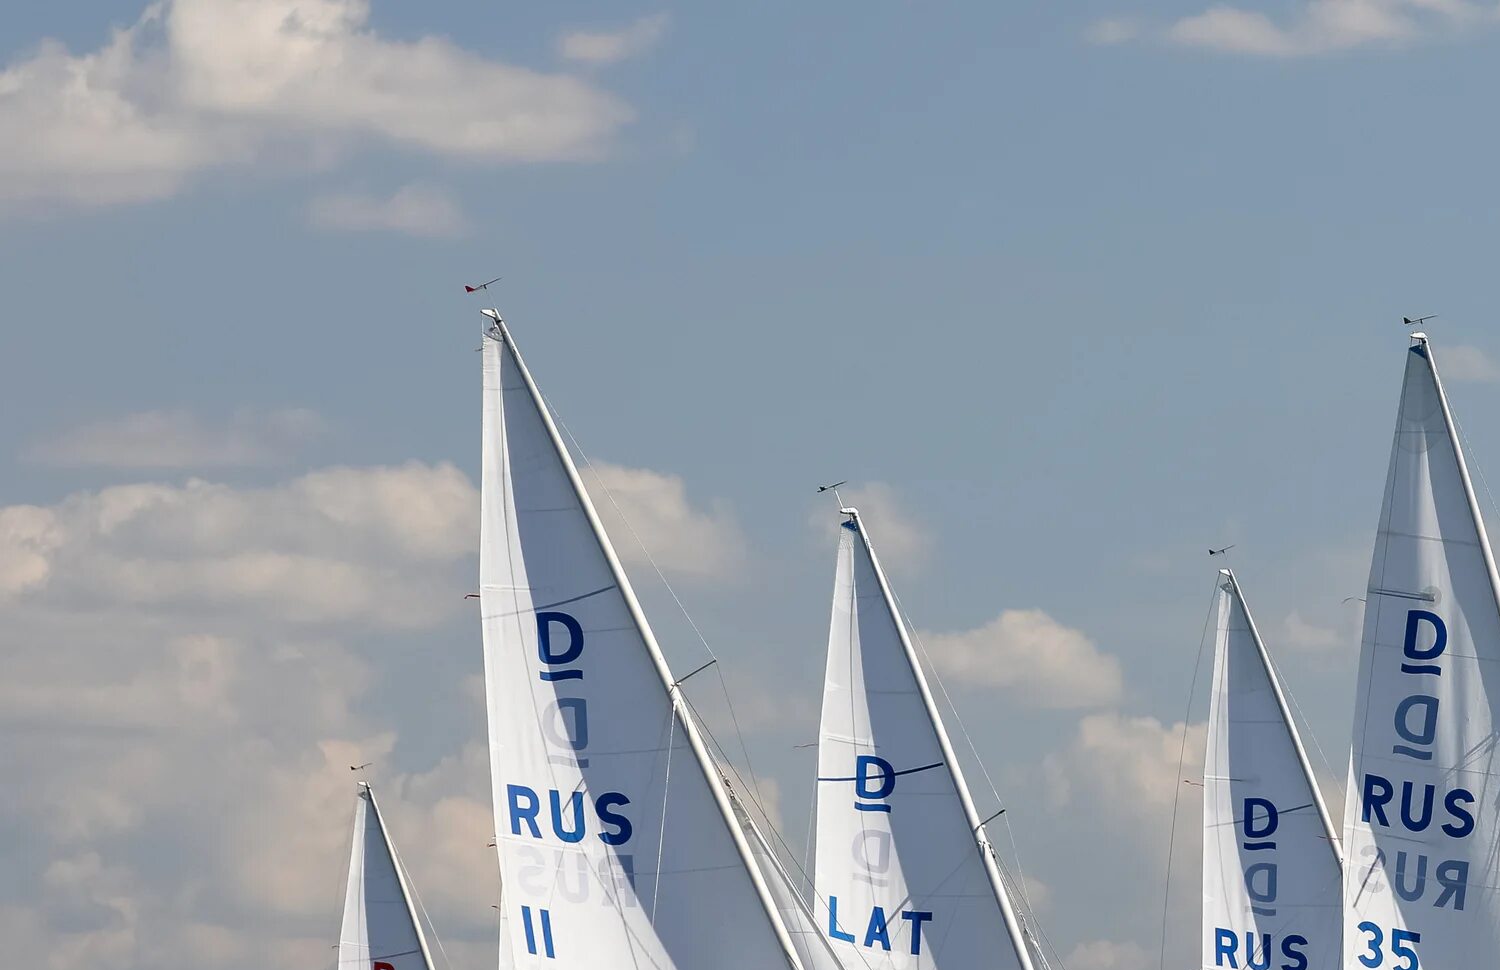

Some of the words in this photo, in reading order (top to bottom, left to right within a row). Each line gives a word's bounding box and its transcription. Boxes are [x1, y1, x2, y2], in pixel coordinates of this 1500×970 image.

[535, 611, 584, 682] D
[1401, 609, 1448, 677] D
[506, 783, 632, 846] RUS
[854, 755, 896, 814] D
[1361, 773, 1475, 839] RUS
[1243, 797, 1279, 851] D
[521, 905, 555, 960] 11
[829, 895, 932, 956] LAT
